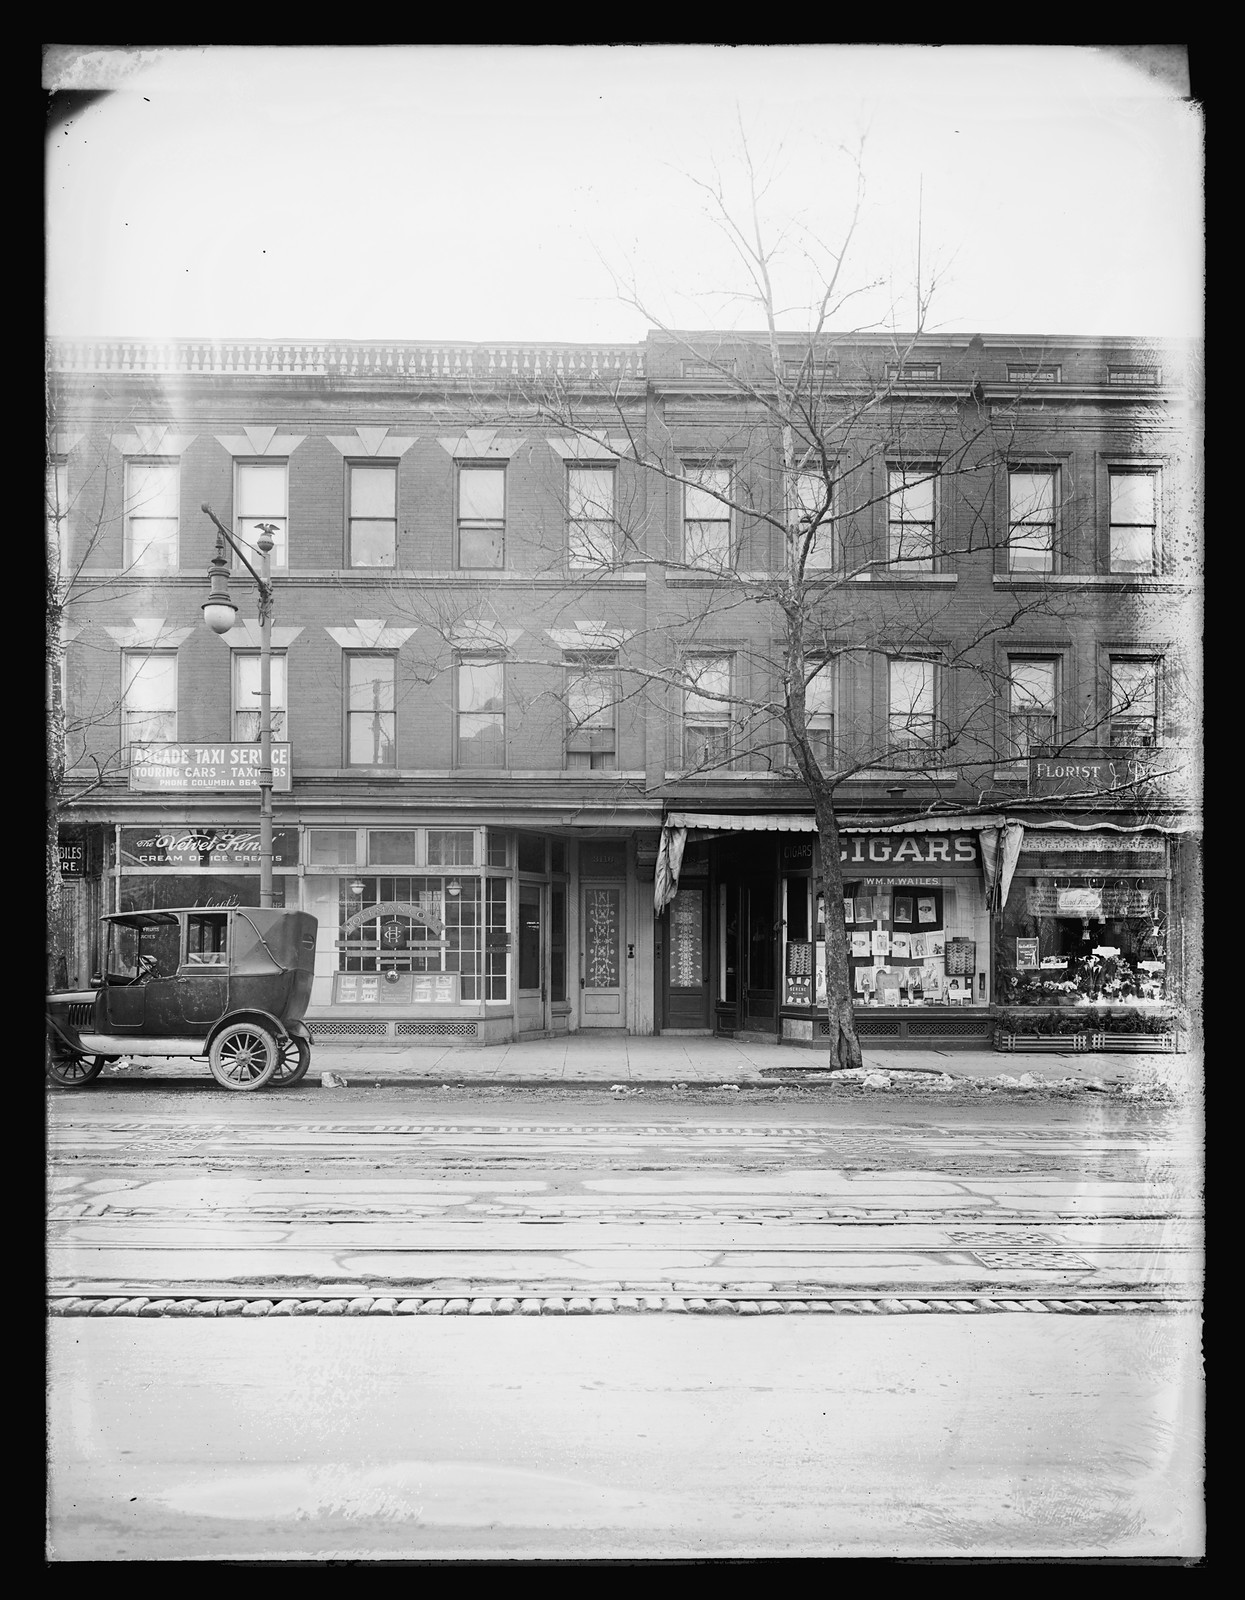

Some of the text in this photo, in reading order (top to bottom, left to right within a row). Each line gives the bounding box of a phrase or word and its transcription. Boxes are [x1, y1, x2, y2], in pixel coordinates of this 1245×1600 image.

[195, 749, 224, 765] TAXI
[230, 749, 288, 765] SERVCE
[134, 767, 180, 778] TOURING
[184, 767, 217, 778] CARS
[230, 767, 287, 778] TAXIBS
[1036, 763, 1101, 778] FLORIST
[59, 847, 82, 859] BILES
[784, 844, 812, 859] CIGARS
